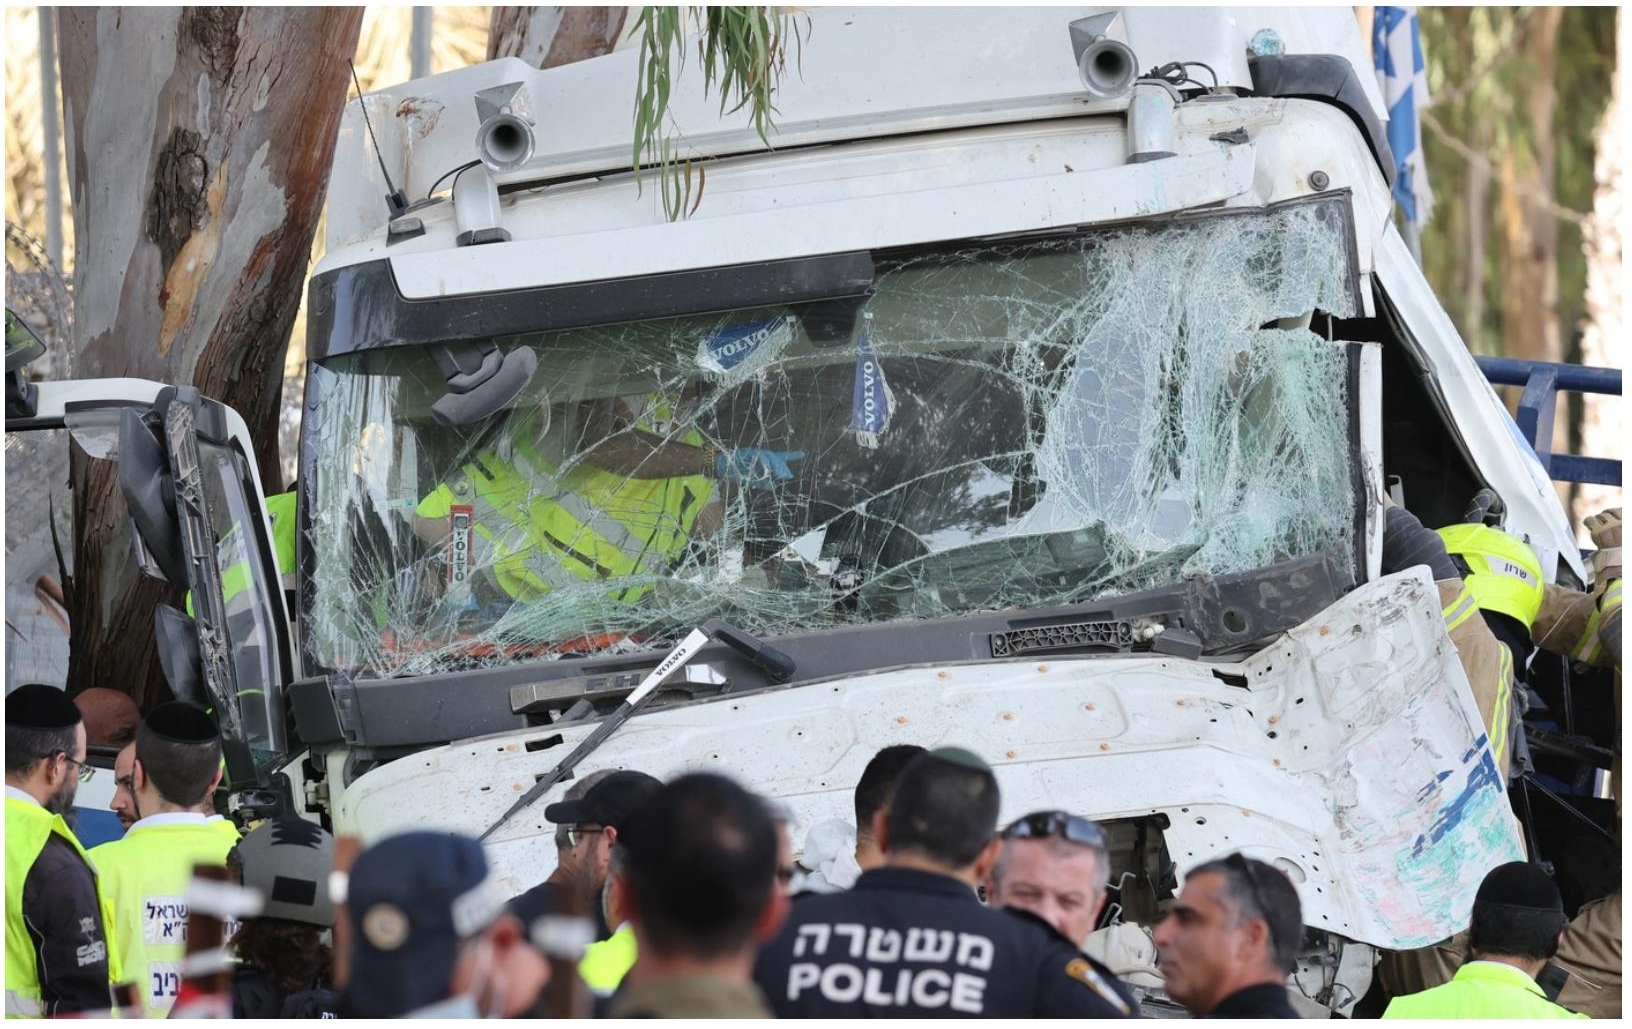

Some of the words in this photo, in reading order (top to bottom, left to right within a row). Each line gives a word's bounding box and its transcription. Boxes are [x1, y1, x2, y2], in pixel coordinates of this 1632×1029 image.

[709, 328, 770, 361] VOLVO
[863, 361, 875, 426] VOLVO
[455, 529, 466, 582] VOLVO
[1504, 563, 1528, 579] שרון
[655, 647, 687, 677] VOLVO
[146, 902, 189, 920] שראל
[793, 922, 995, 971] משטרה
[153, 972, 181, 997] ביב
[785, 962, 988, 1014] POLICE
